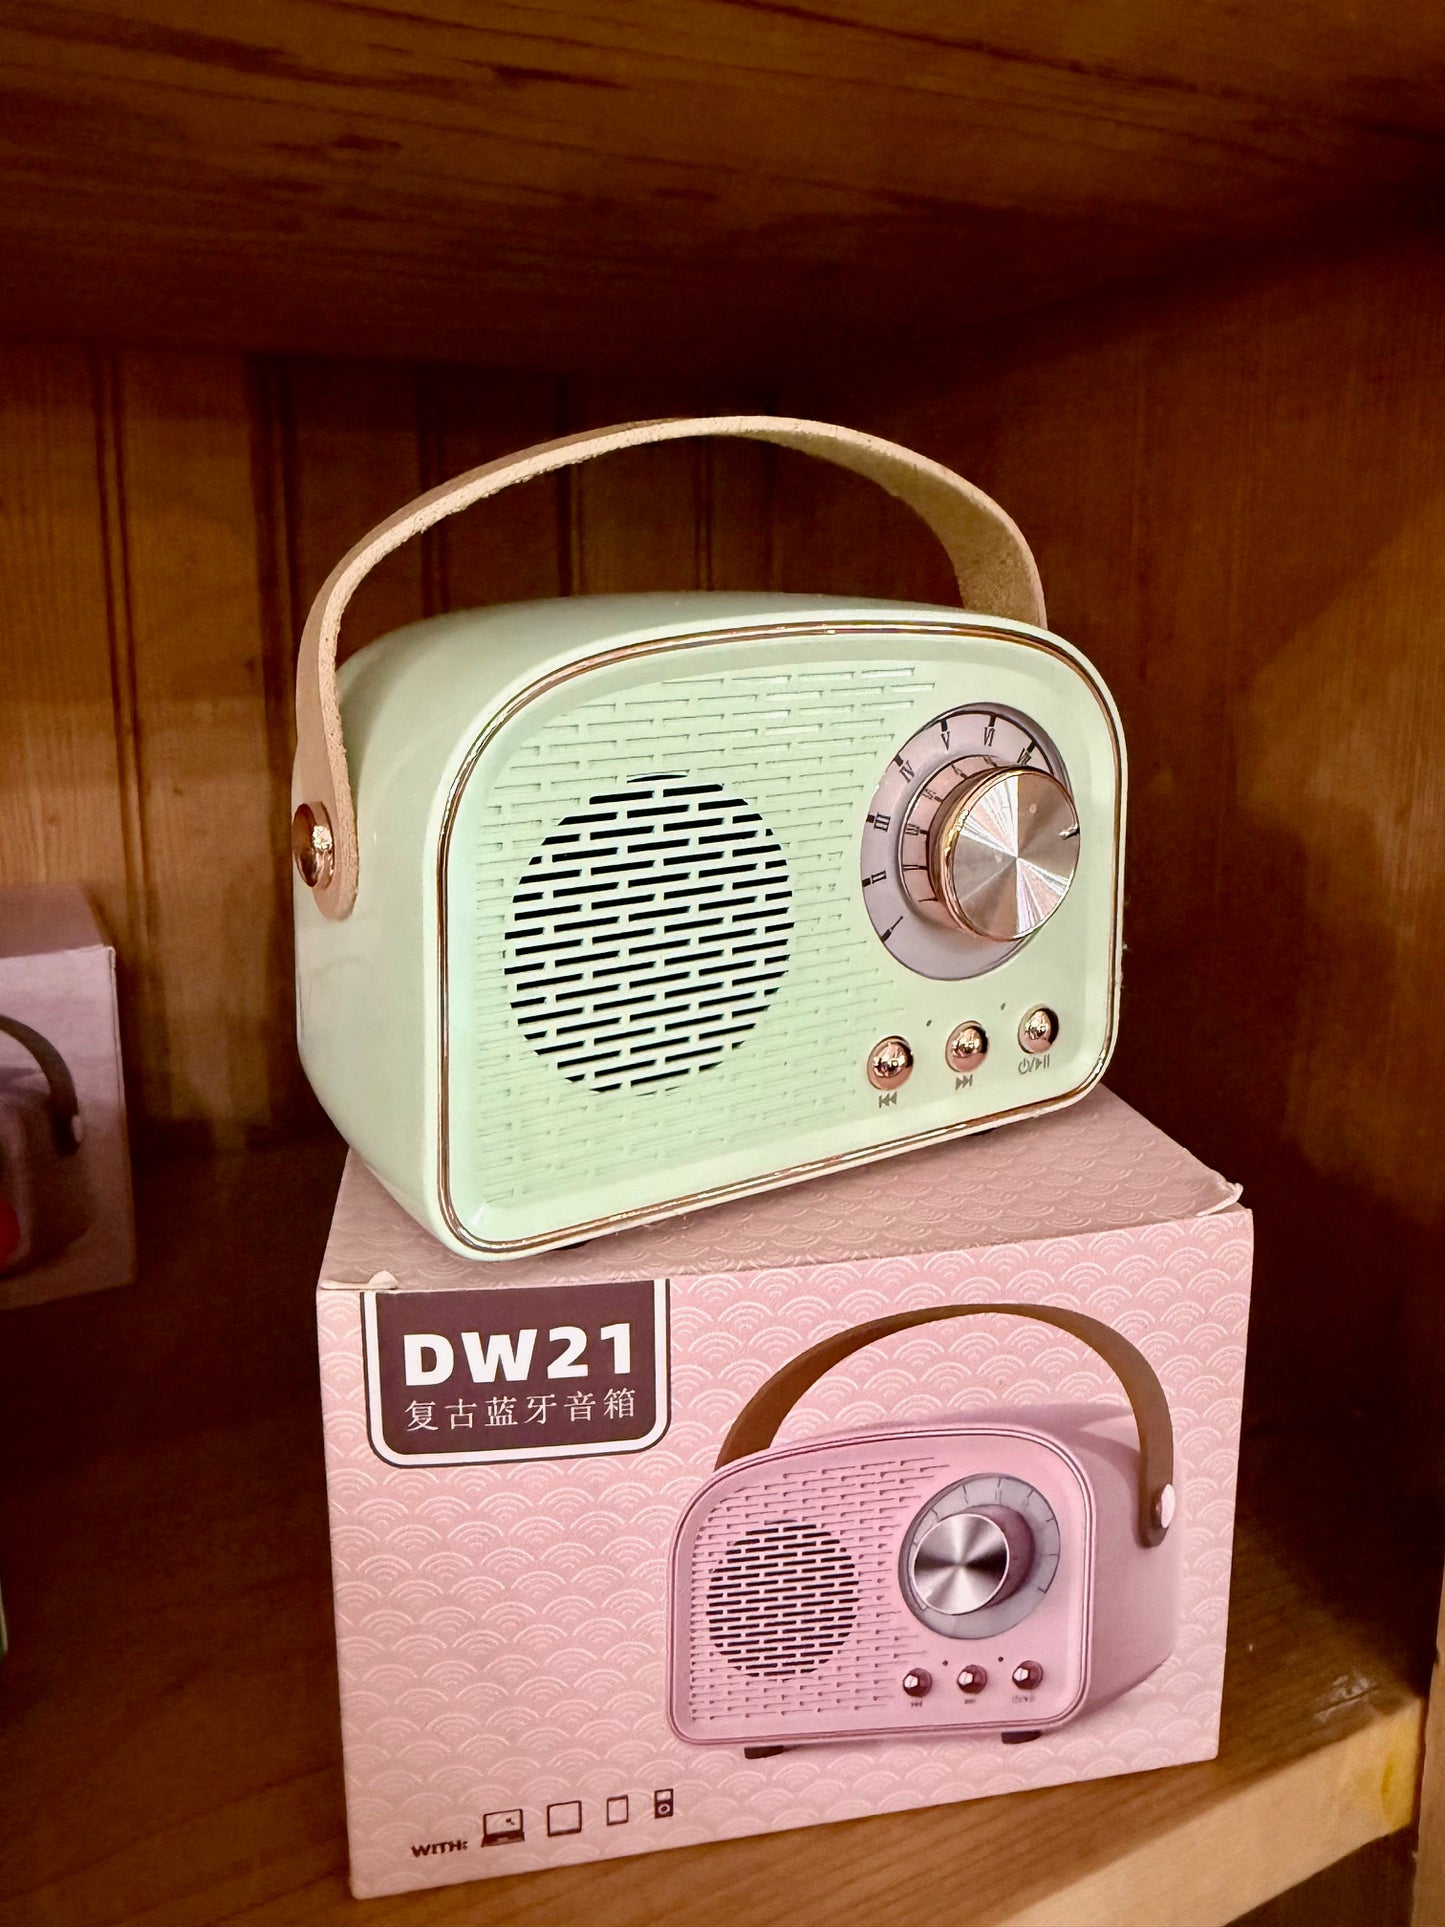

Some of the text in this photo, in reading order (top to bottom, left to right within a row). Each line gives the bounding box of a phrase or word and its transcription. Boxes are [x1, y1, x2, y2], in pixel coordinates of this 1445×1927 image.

[873, 812, 891, 832] III
[404, 1322, 631, 1386] DW21
[404, 1387, 636, 1432] 复古蓝牙音箱
[411, 1840, 468, 1858] WITH:
